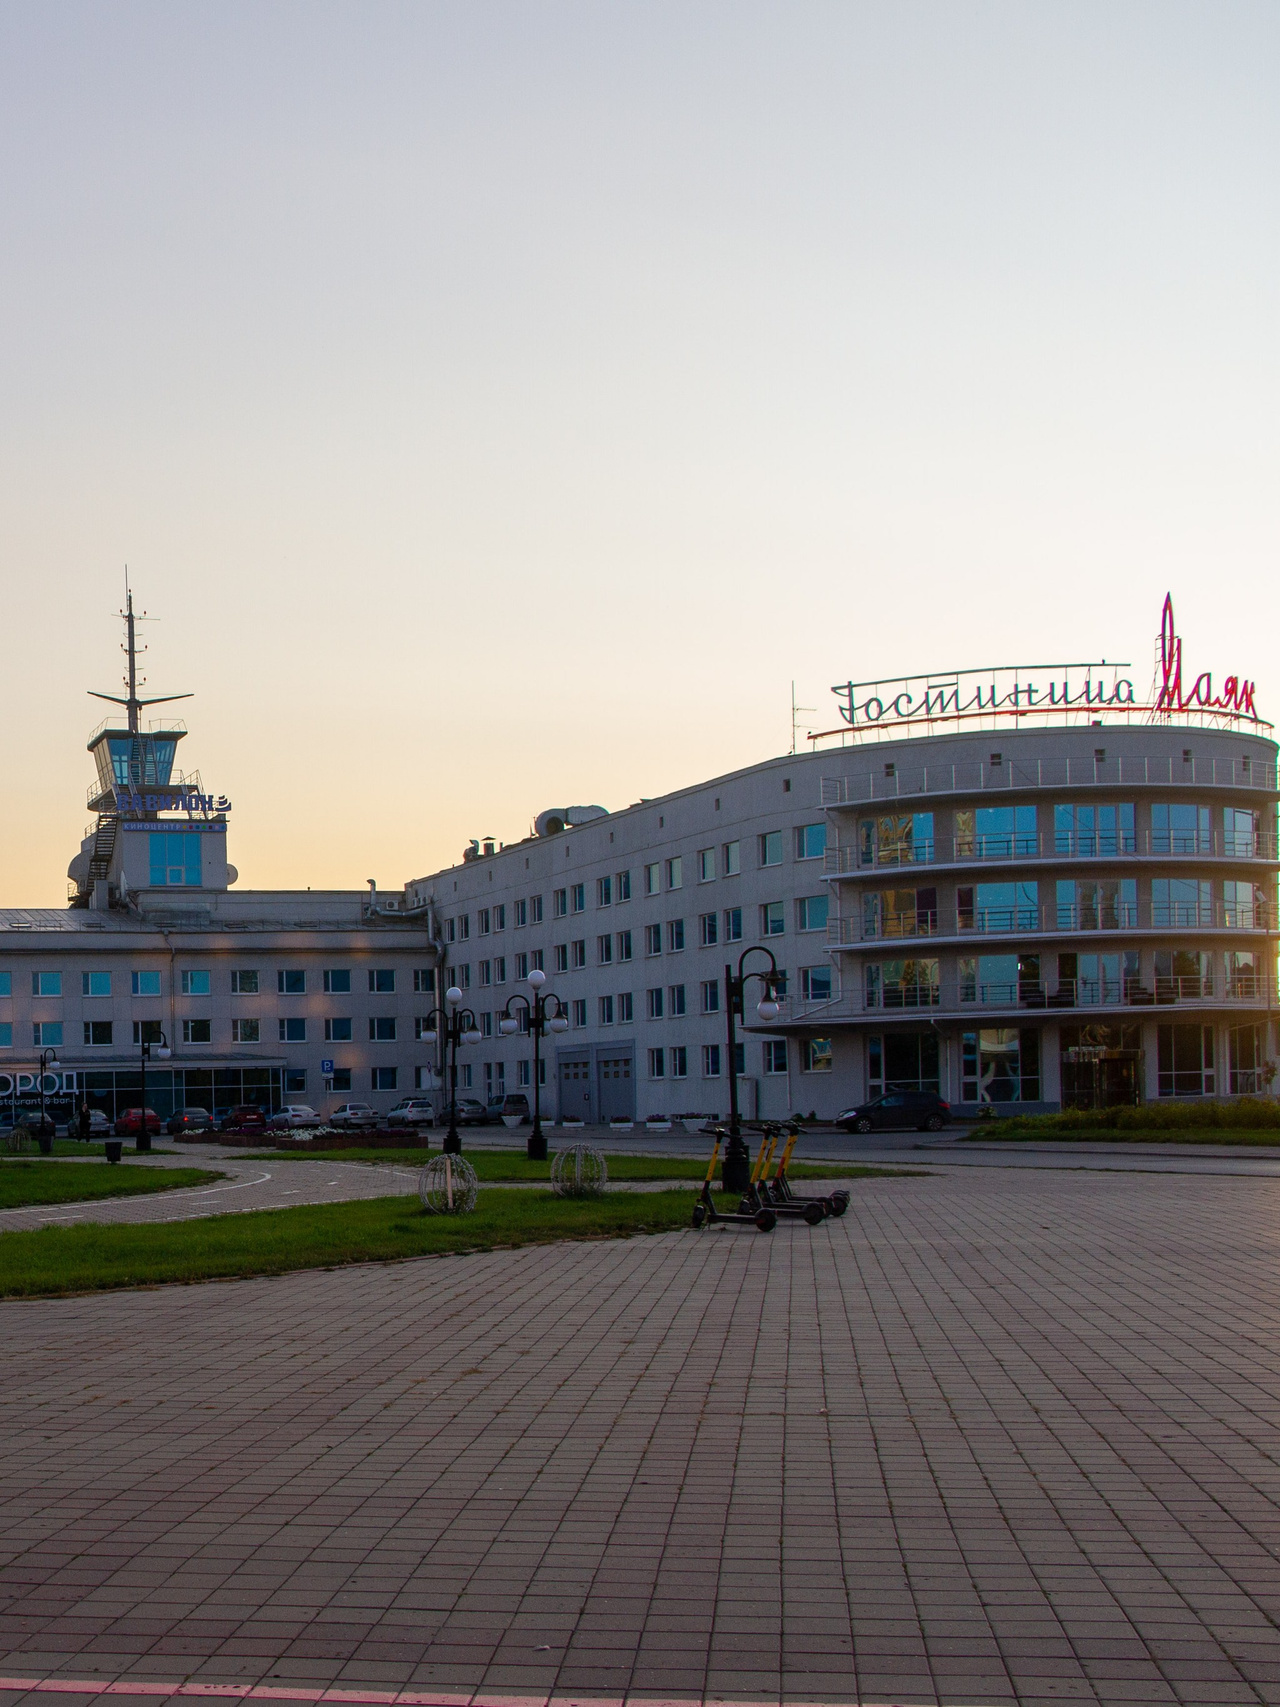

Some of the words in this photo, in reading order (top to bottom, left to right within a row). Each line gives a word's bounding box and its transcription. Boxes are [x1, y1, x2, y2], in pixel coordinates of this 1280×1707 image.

[831, 665, 1135, 724] Гостиница
[1156, 591, 1258, 720] Маяк
[116, 794, 215, 812] ВАВИЛОН
[123, 823, 181, 831] КИНОЦЕНТР
[53, 1096, 70, 1105] bar
